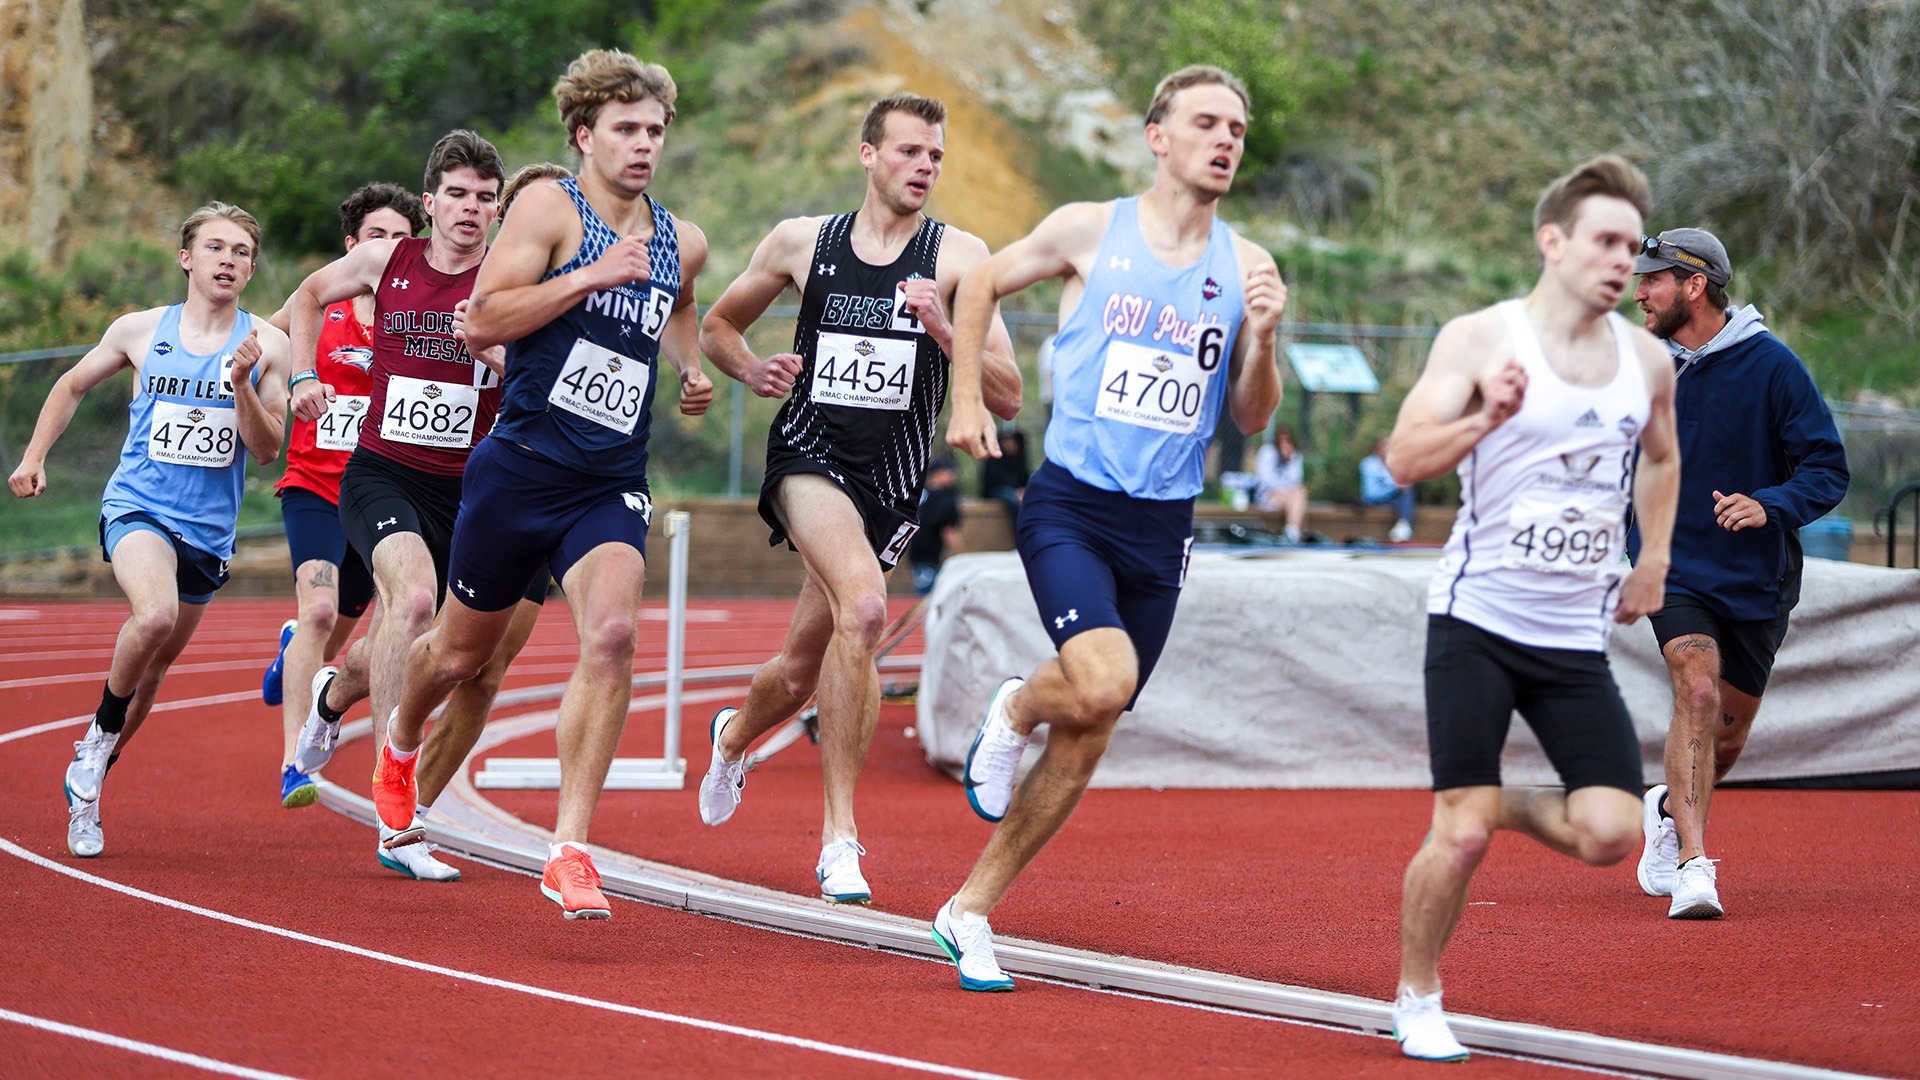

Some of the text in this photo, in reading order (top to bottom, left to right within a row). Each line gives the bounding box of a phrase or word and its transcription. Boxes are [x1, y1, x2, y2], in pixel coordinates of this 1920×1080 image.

[648, 295, 669, 335] 5
[820, 293, 893, 330] BHS
[1103, 292, 1153, 337] CSU
[155, 344, 172, 352] RMAC
[404, 335, 472, 363] MESA
[855, 344, 875, 353] RMAC
[1197, 327, 1224, 371] 6
[148, 375, 235, 400] FORT LE
[423, 386, 442, 396] RMAC
[817, 356, 908, 395] 4454
[561, 365, 641, 419] 4603
[820, 390, 902, 405] RMAC CHAMPIONSHIP
[1104, 369, 1201, 418] 4700
[387, 397, 473, 434] 4682
[559, 395, 629, 427] RMAC CHAMPIONSHIP
[1108, 406, 1191, 427] RMAC CHAMPIONSHIP
[153, 422, 233, 454] 4738
[390, 429, 463, 443] RMAC CHAMPIONSHIP
[156, 450, 228, 463] RMAC CHAMPIONSHIP
[888, 524, 915, 562] 4
[1511, 523, 1610, 564] 4999
